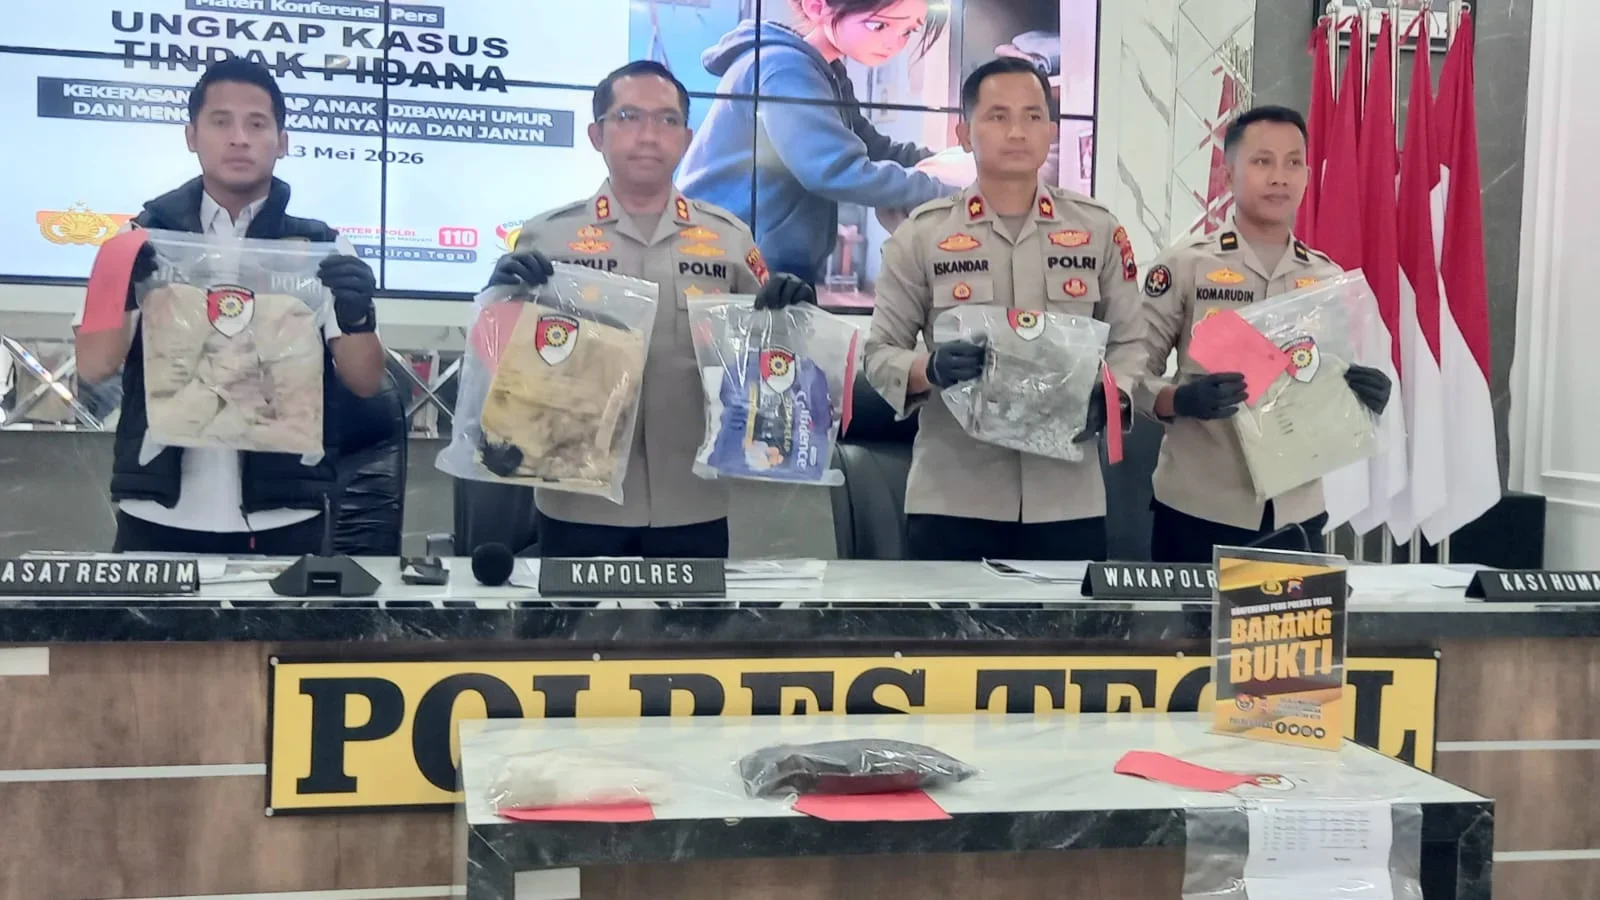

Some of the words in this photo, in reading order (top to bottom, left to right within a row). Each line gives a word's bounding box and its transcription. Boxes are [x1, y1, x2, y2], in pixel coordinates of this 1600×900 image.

[271, 0, 380, 19] Konferensi
[391, 7, 438, 24] Pers
[111, 10, 326, 44] UNGKAP
[342, 26, 510, 59] KASUS
[323, 53, 509, 93] PIDANA
[62, 83, 191, 104] KEKERASAN
[313, 97, 378, 115] ANAK
[388, 103, 486, 123] DIBAWAH
[490, 109, 554, 128] UMUR
[73, 101, 124, 118] DAN
[333, 115, 422, 135] NYAWA
[425, 122, 473, 139] DAN
[477, 126, 545, 143] JANIN
[314, 146, 356, 161] Mei
[364, 148, 425, 165] 2026
[441, 230, 476, 247] 110
[364, 247, 421, 259] Polres
[427, 250, 471, 262] Tegal
[1047, 255, 1097, 271] POLRI
[678, 261, 727, 280] POLRI
[933, 259, 989, 276] ISKANDAR
[1196, 287, 1255, 303] KOMARUDIN
[0, 561, 195, 584] ASATRESKRIM
[571, 562, 695, 585] KAPOLRES
[1103, 566, 1219, 589] WAKAPOLR
[1498, 572, 1548, 592] KASI
[1548, 572, 1600, 592] HUMA
[1230, 607, 1333, 645] BARANG
[1229, 637, 1334, 685] BUKTI
